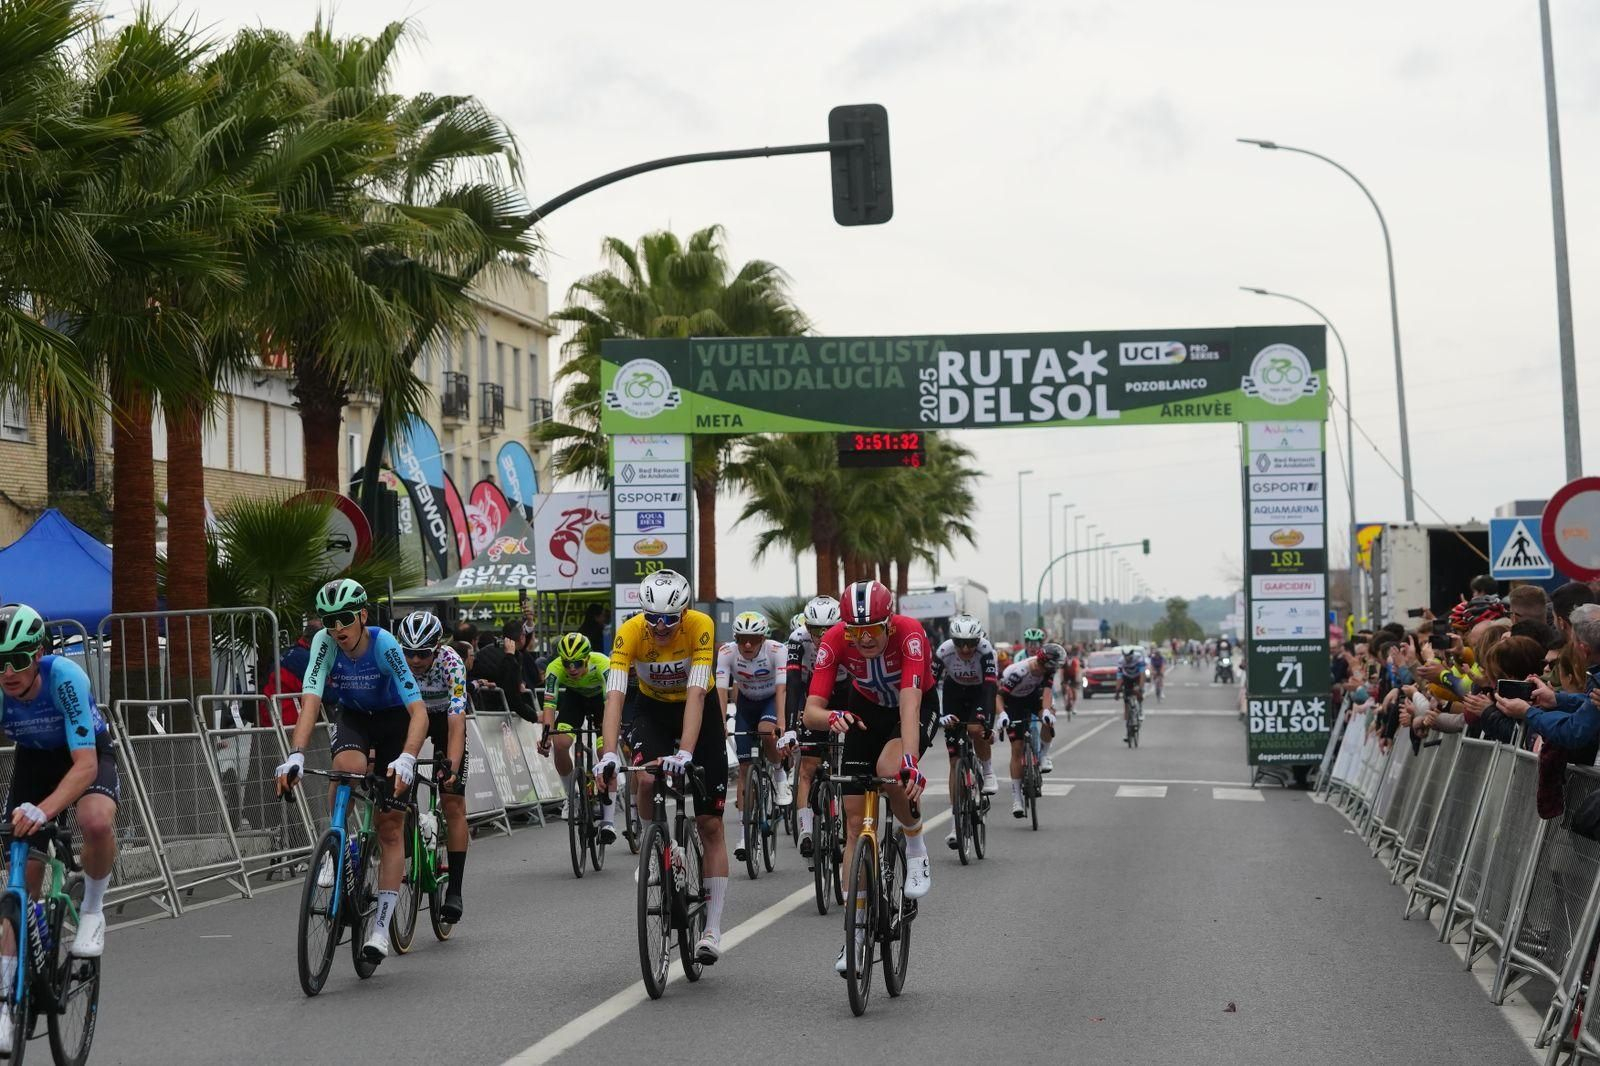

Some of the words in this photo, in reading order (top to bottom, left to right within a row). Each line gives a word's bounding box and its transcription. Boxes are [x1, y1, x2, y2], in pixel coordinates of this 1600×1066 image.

[697, 342, 811, 366] VUELTA
[819, 340, 948, 364] CICLISTA
[1124, 346, 1160, 361] UCI
[1189, 344, 1209, 352] PRO
[1189, 351, 1220, 360] SERIES
[698, 369, 719, 391] A
[726, 363, 906, 391] ANDALUCÍA
[1125, 378, 1208, 393] POZOBLANCO
[919, 367, 939, 423] 2025
[696, 414, 743, 428] META
[855, 432, 919, 451] 3:51:32
[1252, 482, 1307, 493] GSPORT
[617, 492, 671, 503] GSPORT
[1253, 504, 1320, 514] AQUAMARINA
[591, 567, 610, 576] UCI
[1263, 581, 1313, 591] GARCIDEN
[311, 641, 329, 678] DECATHLON
[649, 661, 684, 674] UAE
[1276, 662, 1304, 688] 71
[30, 928, 47, 974] RYSEL
